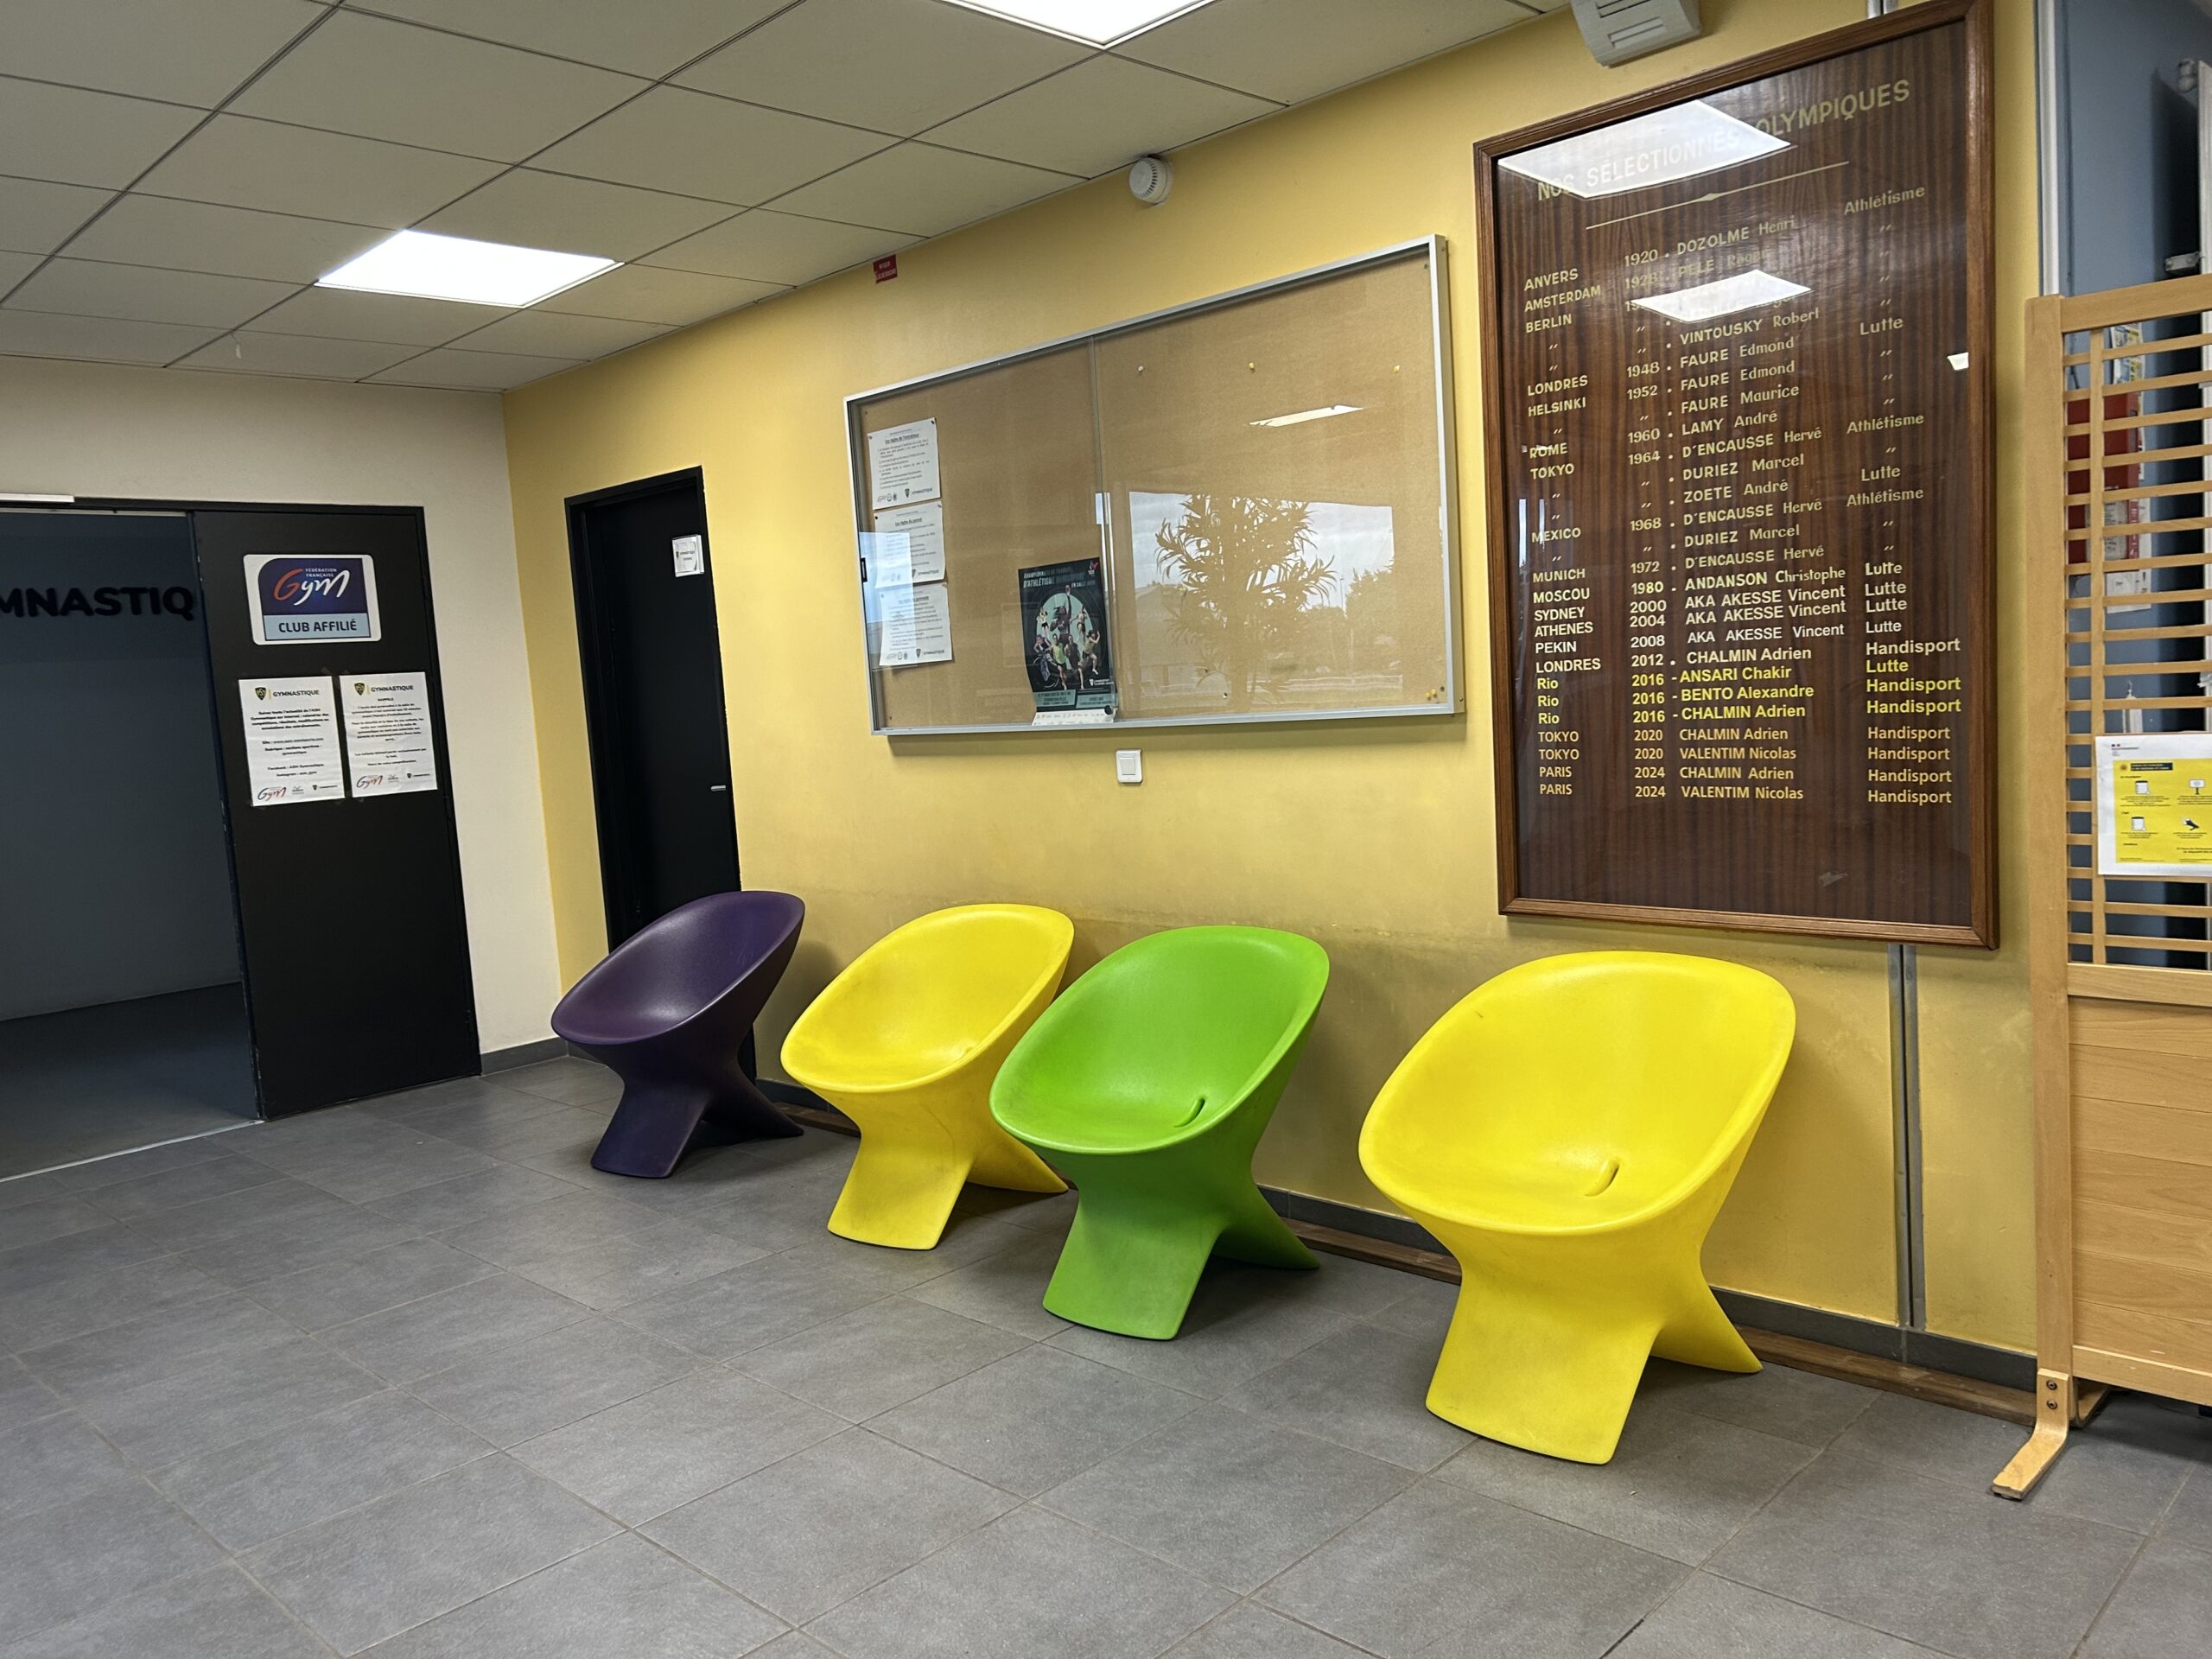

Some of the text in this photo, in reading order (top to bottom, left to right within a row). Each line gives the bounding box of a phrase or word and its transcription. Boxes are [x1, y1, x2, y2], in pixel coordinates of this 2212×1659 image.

[1538, 79, 1910, 201] NOS SÉLECTIONNÉS OLYMPIQUES
[1524, 187, 1925, 291] ANVERS 1920 DOZOLME Henri Athlétisme
[1524, 285, 1601, 312] AMSTERDAM
[1526, 314, 1572, 333] BERLIN
[1680, 307, 1819, 345] VINTOUSKY Robert
[1528, 317, 1904, 396] LONDRES 1948 FAURE Edmond Lutte
[1528, 359, 1795, 416] HELSINKI 1952 FAURE Edmond
[1681, 384, 1799, 414] FAURE Maurice
[1529, 410, 1777, 459] ROME 1960 LAMY André
[1530, 463, 1574, 480] TOKYO
[1628, 450, 1661, 465] 1964
[1784, 427, 1822, 443] Hervé
[1847, 415, 1924, 434] Athlétisme
[1683, 454, 1804, 480] DURIEZ Marcel
[1684, 466, 1901, 503] ZOETE André Lutte
[1532, 527, 1581, 543] MEXICO
[1630, 518, 1662, 531] 1968
[1783, 499, 1822, 514] Hervé
[1847, 489, 1923, 507] Athlétisme
[1685, 524, 1800, 547] DURIEZ Marcel
[1533, 569, 1586, 583] MUNICH
[1630, 562, 1660, 574] 1972
[1783, 545, 1824, 560] Hervé
[1533, 562, 1903, 603] MOSCOU 1980 ANDANSON Christophe Lutte
[1535, 582, 1907, 621] SYDNEY 2000 AKA AKESSE Vincent Lutte
[1535, 598, 1907, 637] ATHENES 2004 AKA AKESSE Vincent Lutte
[278, 619, 358, 632] CLUB AFFILIÉ
[1535, 621, 1902, 653] PEKIN 2008 AKA AKESSE Vincent Lutte
[1535, 638, 1961, 673] LONDRES 2012 CHALMIN Adrien Handisport
[1537, 659, 1909, 690] Rio 2016 ANSARI Chakir Lutte
[1537, 677, 1961, 707] Rio 2016 BENTO Alexandre Handisport
[1538, 699, 1961, 724] Rio 2016 CHALMIN Adrien Handisport
[1538, 726, 1950, 742] TOKYO 2020 CHALMIN Adrien Handisport
[1538, 747, 1950, 763] TOKYO 2020 VALENTIM Nicolas Handisport
[1539, 766, 1952, 785] PARIS 2024 CHALMIN Adrien Handisport
[1540, 784, 1952, 806] PARIS 2024 VALENTIM Nicolas Handisport
